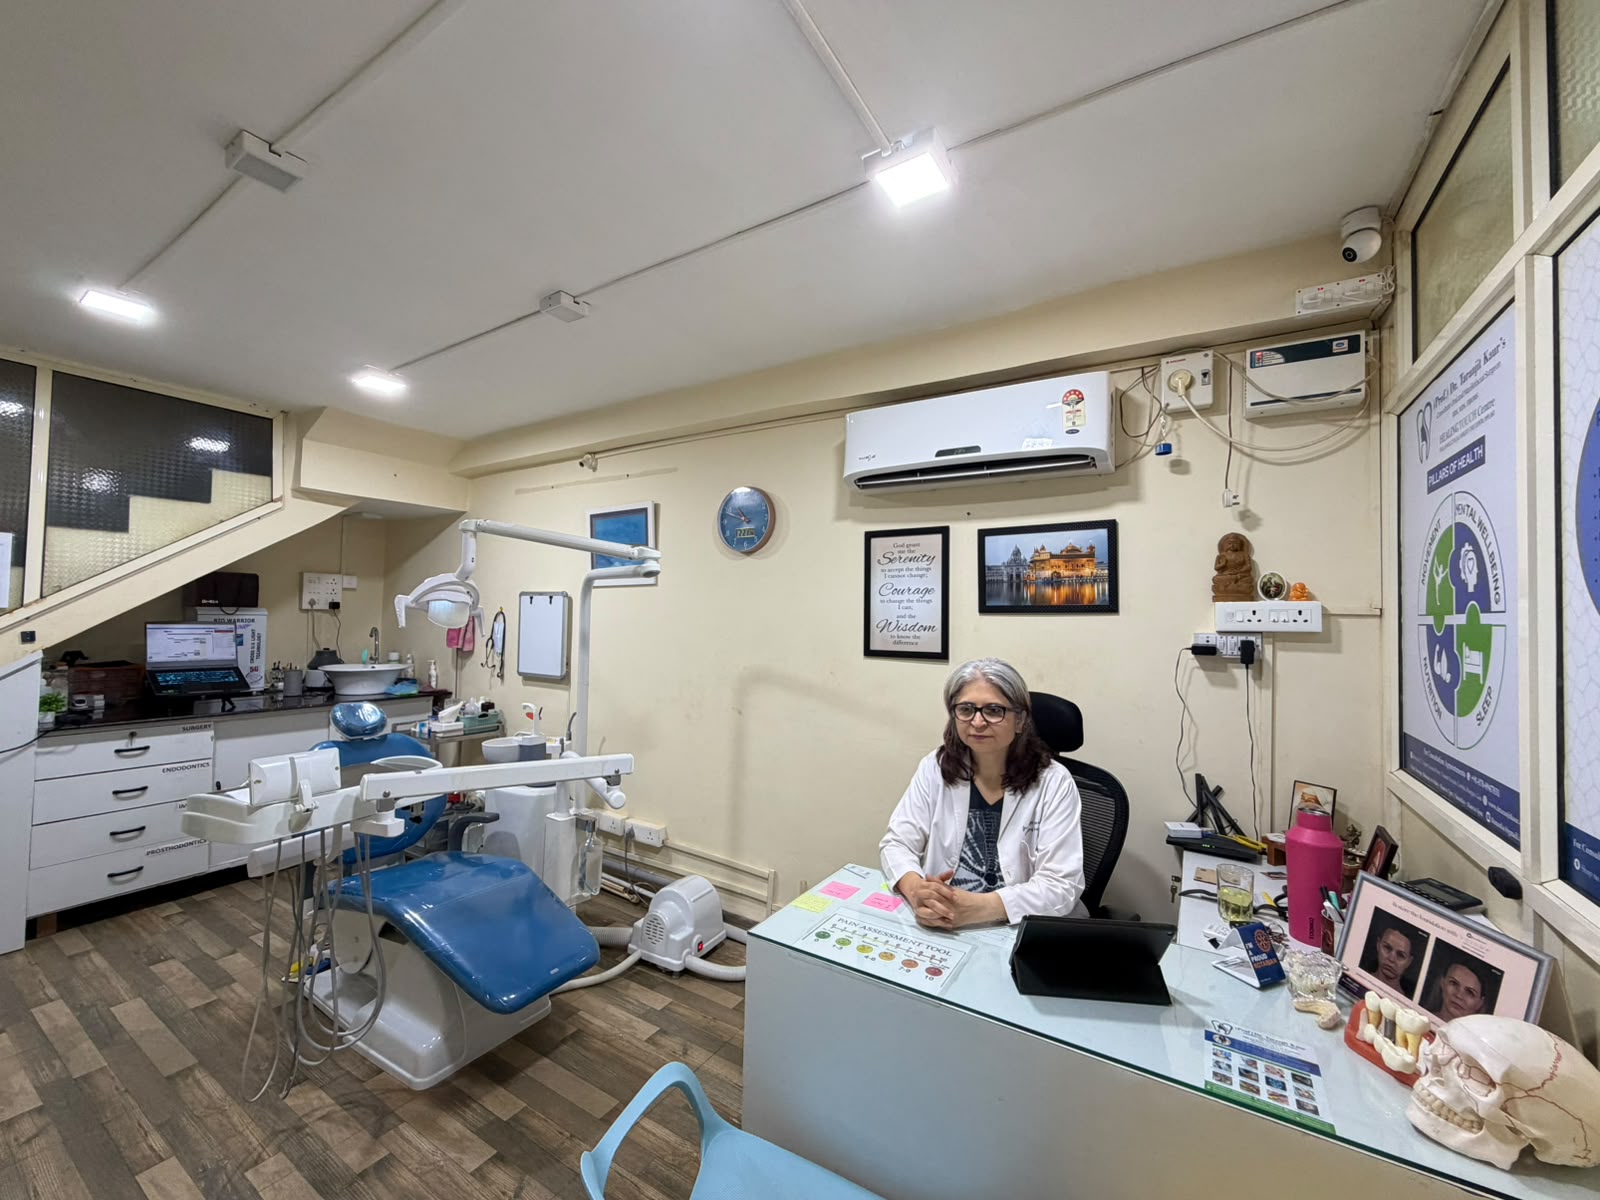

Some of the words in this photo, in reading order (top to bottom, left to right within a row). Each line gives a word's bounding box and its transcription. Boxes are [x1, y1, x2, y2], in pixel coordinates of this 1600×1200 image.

[1428, 465, 1449, 487] PILLARS
[1449, 460, 1457, 475] OF
[1458, 444, 1483, 470] HEALTH
[876, 551, 936, 566] Serenity
[1422, 518, 1442, 586] MOVEMENT
[878, 582, 935, 599] Courage
[915, 597, 933, 605] things
[876, 618, 937, 633] Wisdom
[1424, 656, 1442, 720] NUTRITION
[1476, 685, 1493, 727] SLEEP
[181, 723, 212, 732] SURGERY
[161, 761, 210, 774] ENDODONTICS
[145, 838, 207, 857] PROSTHODONTICS
[837, 917, 860, 928] PAIN
[860, 925, 924, 948] ASSESSMENT
[925, 944, 953, 957] TOOL
